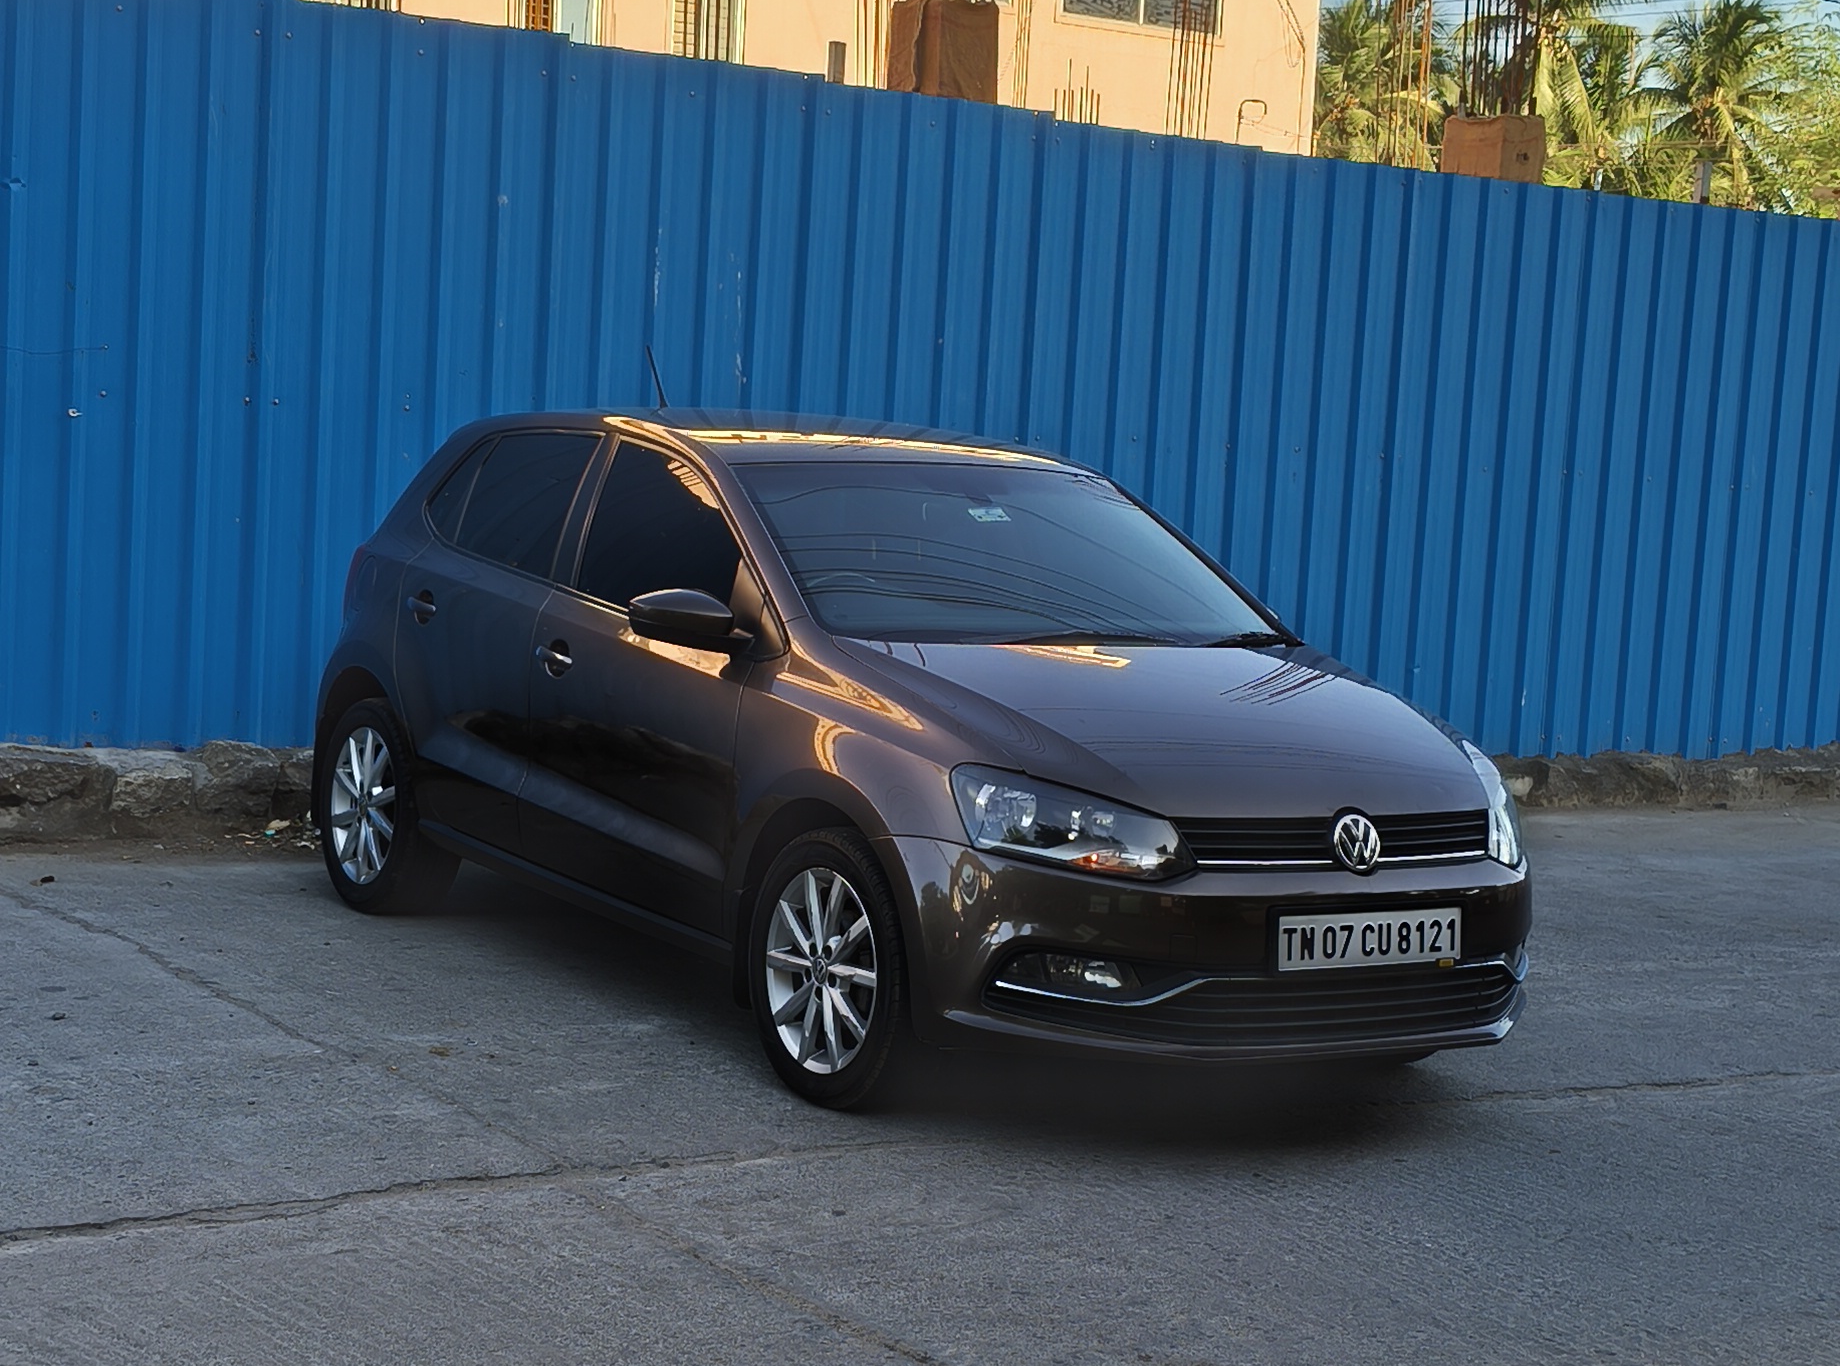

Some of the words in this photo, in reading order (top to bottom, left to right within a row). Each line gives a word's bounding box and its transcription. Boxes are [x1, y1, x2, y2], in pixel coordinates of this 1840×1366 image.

[1282, 926, 1316, 962] TN
[1322, 924, 1355, 960] 07
[1361, 922, 1393, 958] CU
[1397, 917, 1457, 956] 8121
